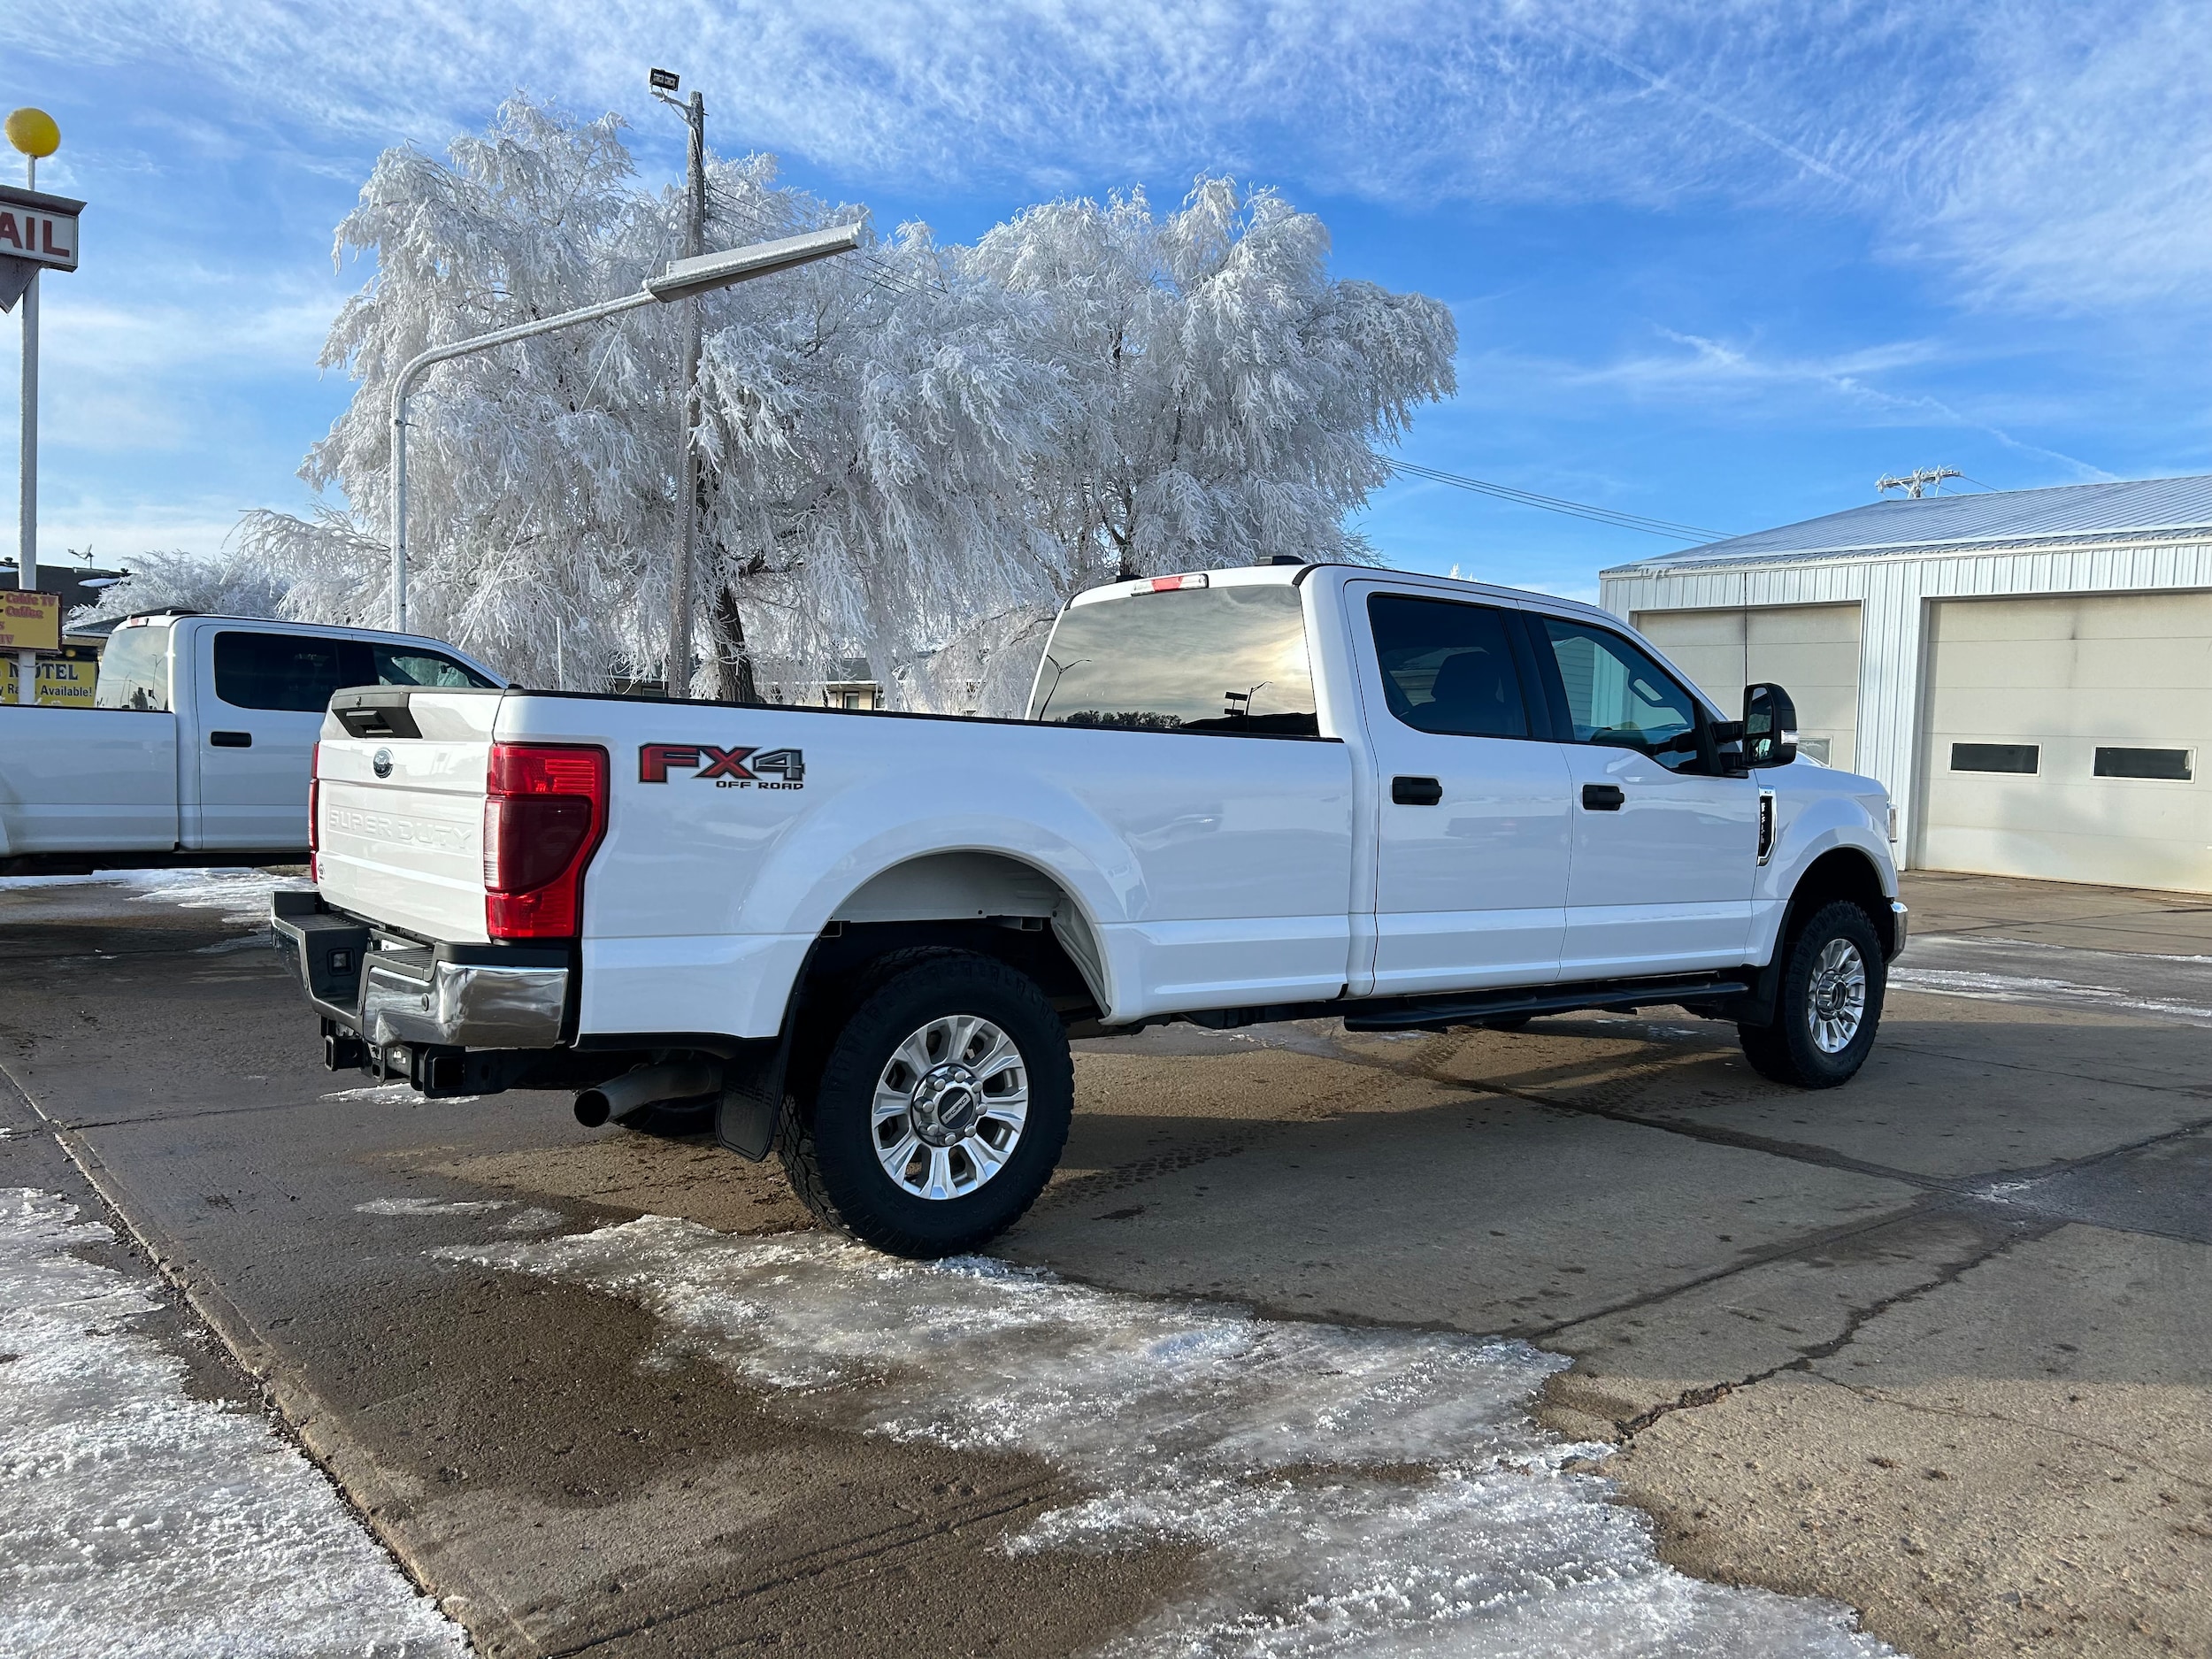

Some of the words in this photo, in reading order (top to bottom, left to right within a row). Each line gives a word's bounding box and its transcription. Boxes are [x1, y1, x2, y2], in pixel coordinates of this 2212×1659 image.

[5, 593, 39, 605] Cable
[40, 595, 58, 607] TV
[41, 685, 92, 697] Available!
[638, 741, 806, 785] FX4
[758, 781, 804, 790] ROAD
[328, 810, 392, 838] SUPER
[396, 821, 473, 849] DUTY
[945, 1097, 967, 1119] FORD
